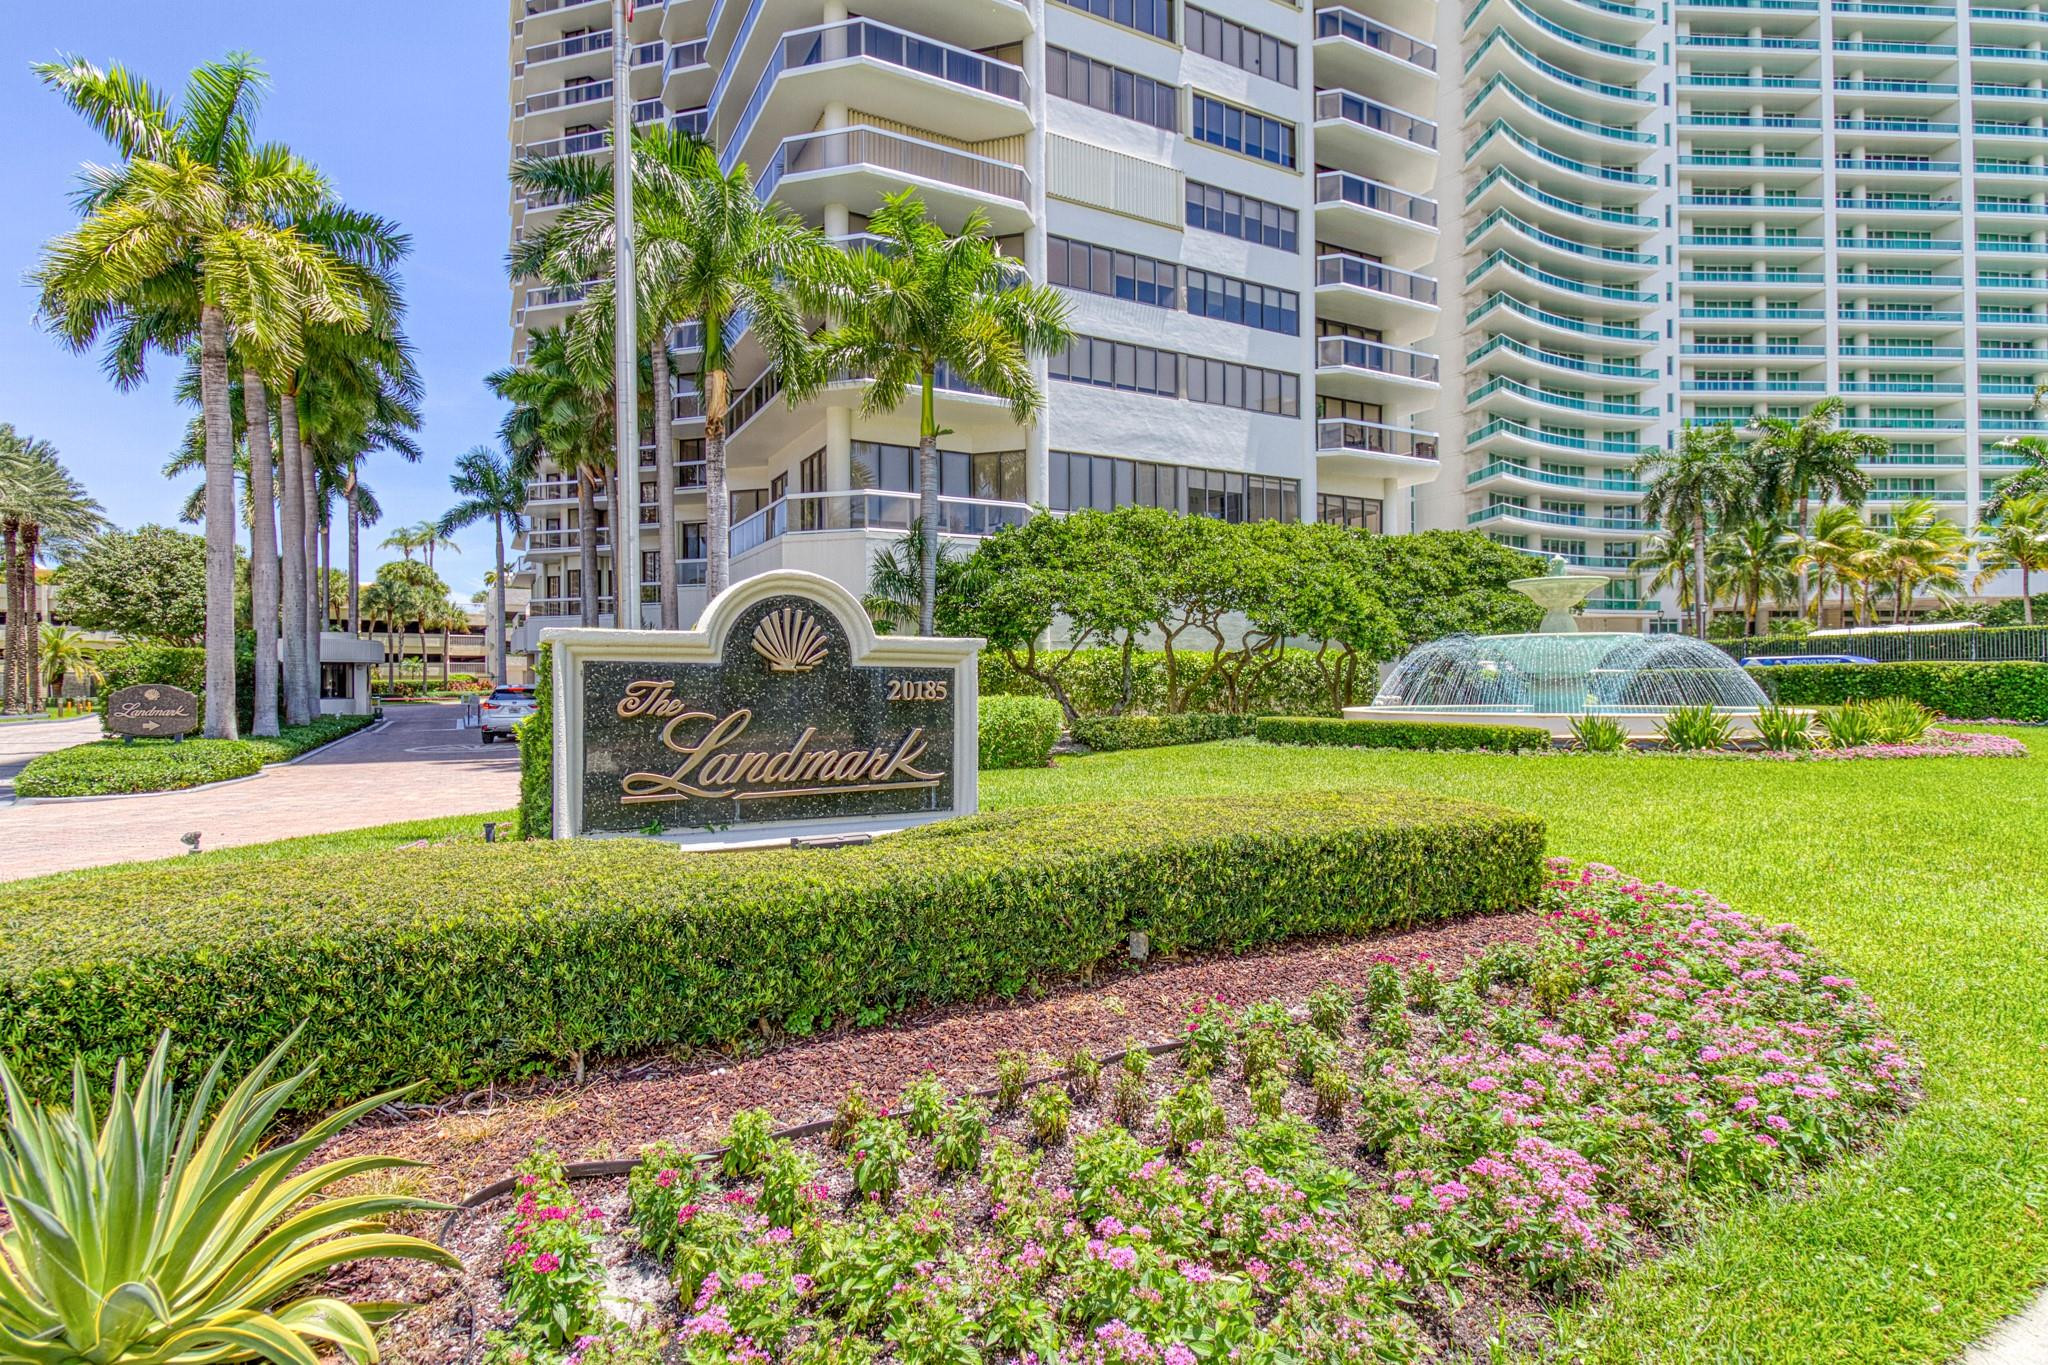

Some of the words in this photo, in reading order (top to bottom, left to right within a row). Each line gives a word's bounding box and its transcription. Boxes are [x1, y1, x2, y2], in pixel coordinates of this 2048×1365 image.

[617, 680, 685, 717] The
[886, 680, 947, 700] 20185
[114, 702, 190, 718] Landmark
[622, 709, 945, 798] Landmark
